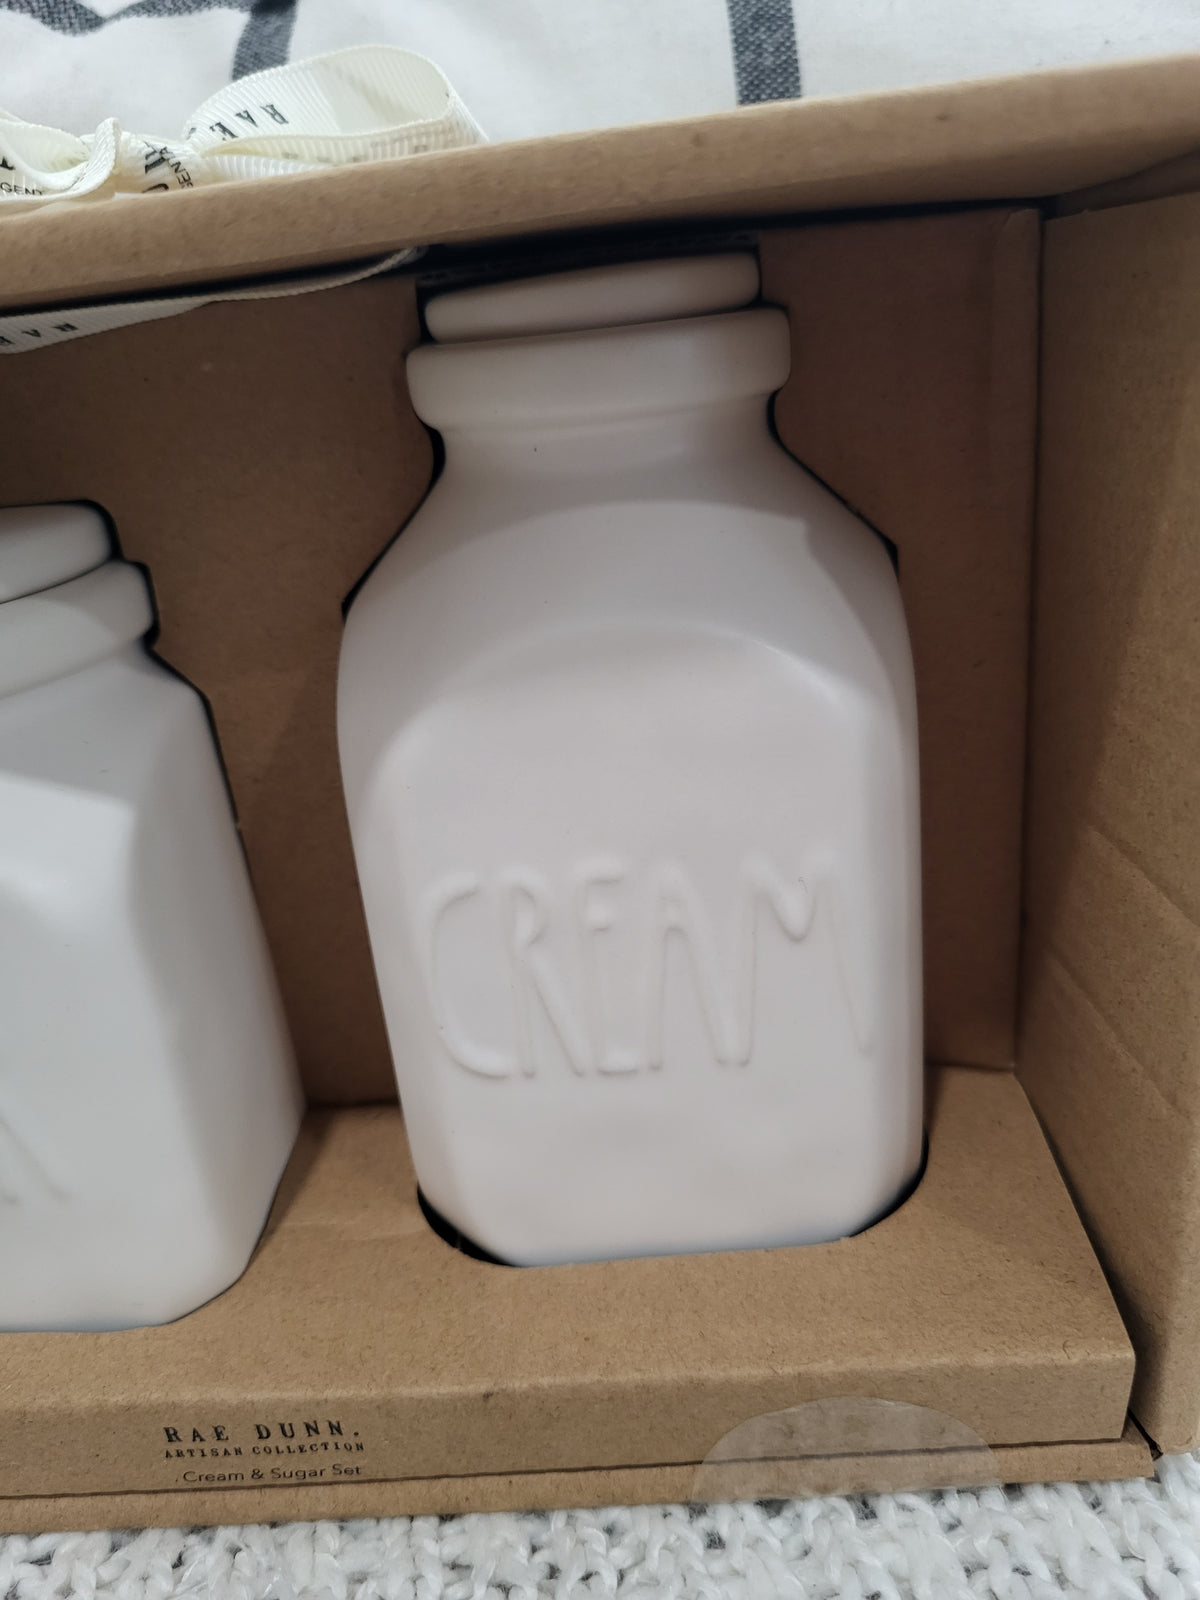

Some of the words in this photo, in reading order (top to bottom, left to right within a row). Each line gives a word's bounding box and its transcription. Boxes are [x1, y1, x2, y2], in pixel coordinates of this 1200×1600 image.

[410, 852, 877, 1080] CREAM
[163, 1425, 230, 1443] RAE
[254, 1419, 361, 1440] DUNN.
[164, 1447, 243, 1459] ARTISAN
[252, 1441, 365, 1455] COLLECTION
[183, 1470, 245, 1483] Cream
[251, 1468, 264, 1480] &
[270, 1467, 326, 1480] Sugar
[332, 1463, 363, 1476] Set
